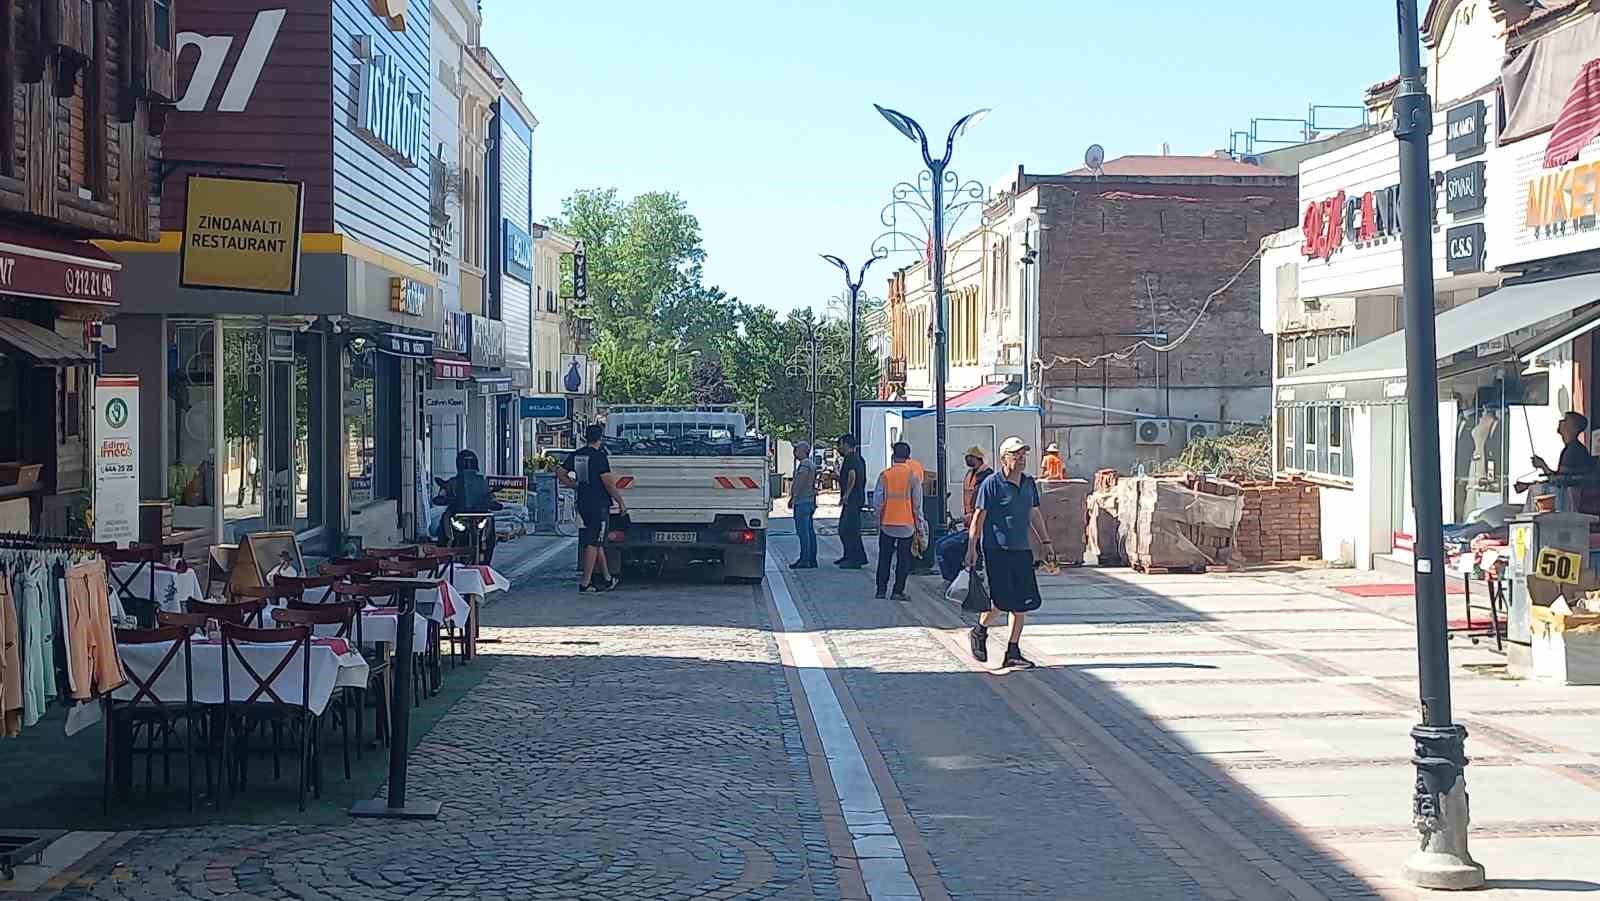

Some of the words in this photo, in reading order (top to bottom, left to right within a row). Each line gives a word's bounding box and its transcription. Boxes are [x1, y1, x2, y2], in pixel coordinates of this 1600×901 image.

[198, 215, 282, 235] ZINDANALTI
[191, 233, 287, 253] RESTAURANT
[101, 272, 112, 297] 49
